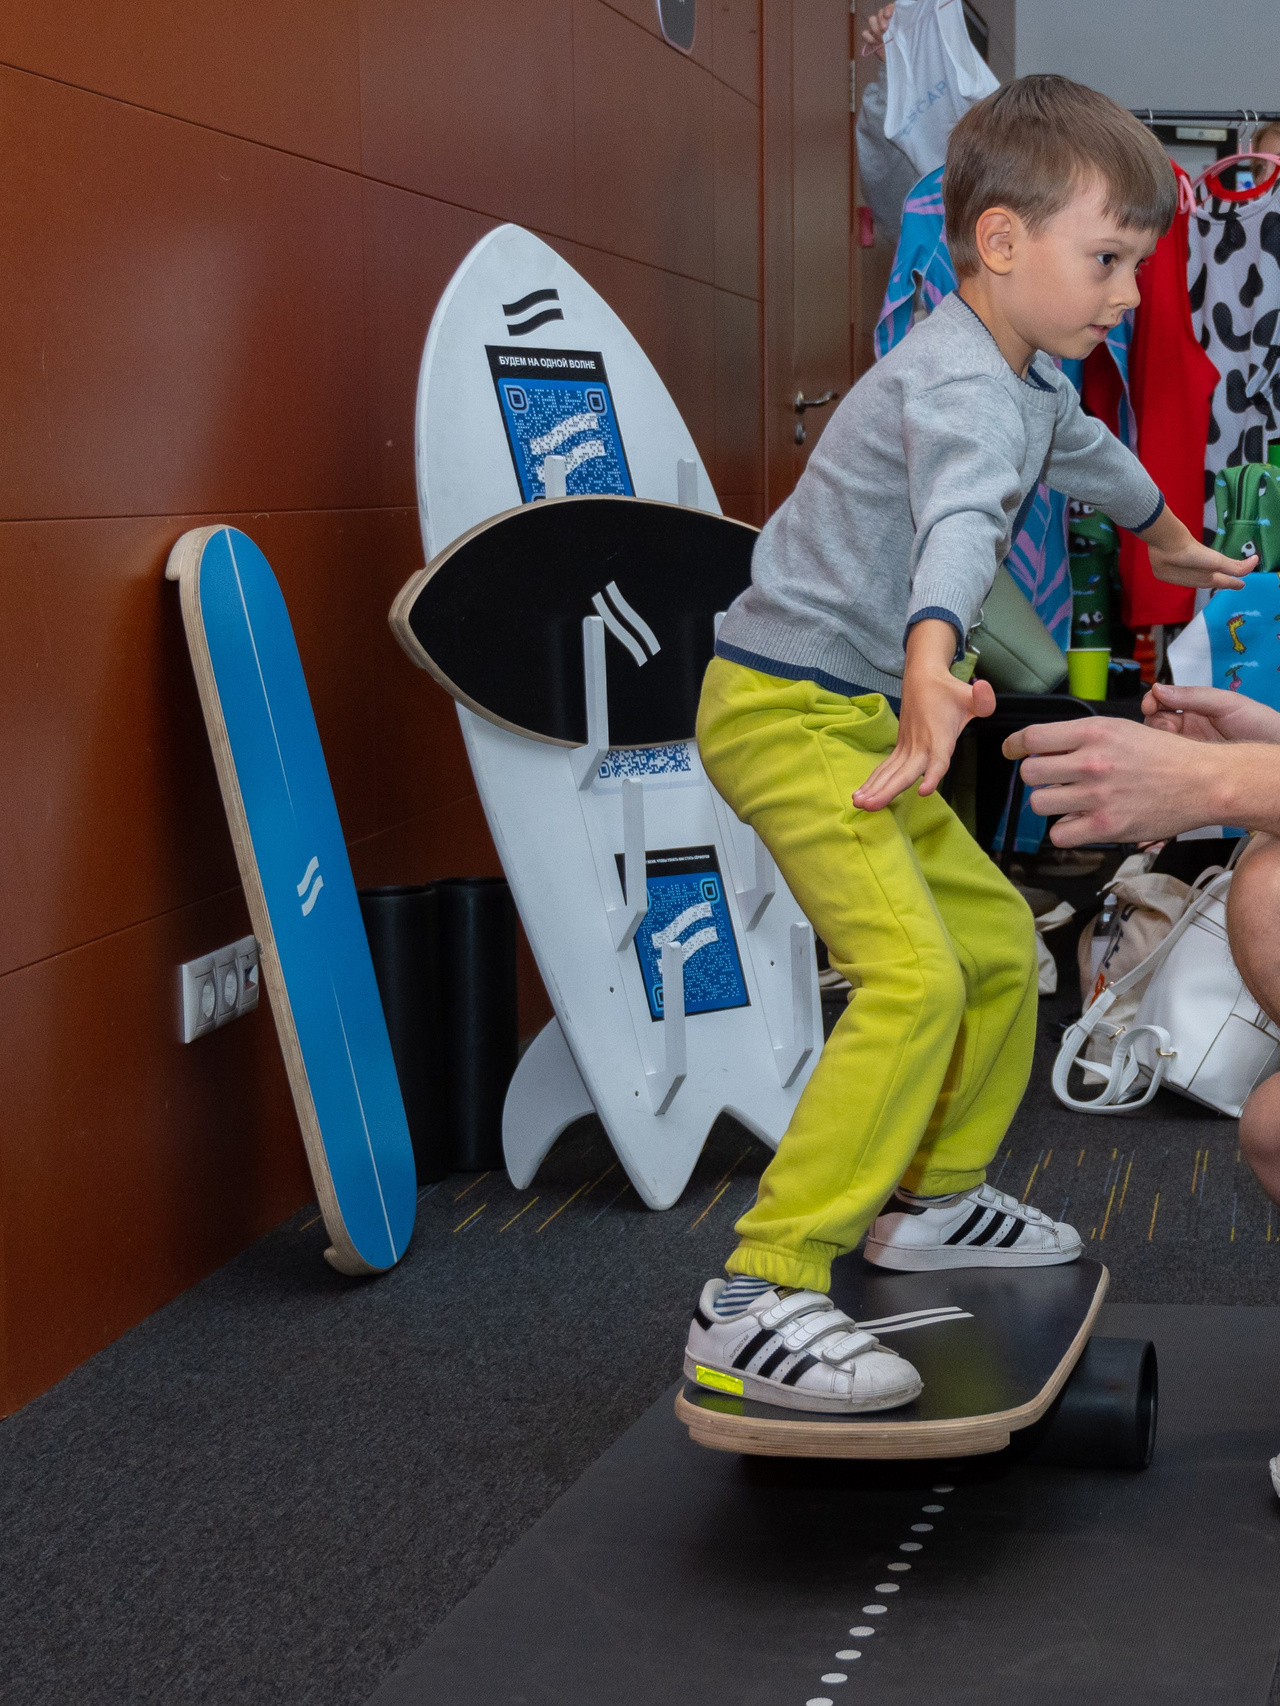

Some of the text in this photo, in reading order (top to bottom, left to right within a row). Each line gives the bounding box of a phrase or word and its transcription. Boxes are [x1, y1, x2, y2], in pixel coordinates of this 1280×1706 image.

[499, 356, 596, 369] БУДЕМ НА ОДНОЙ ВОЛНЕ
